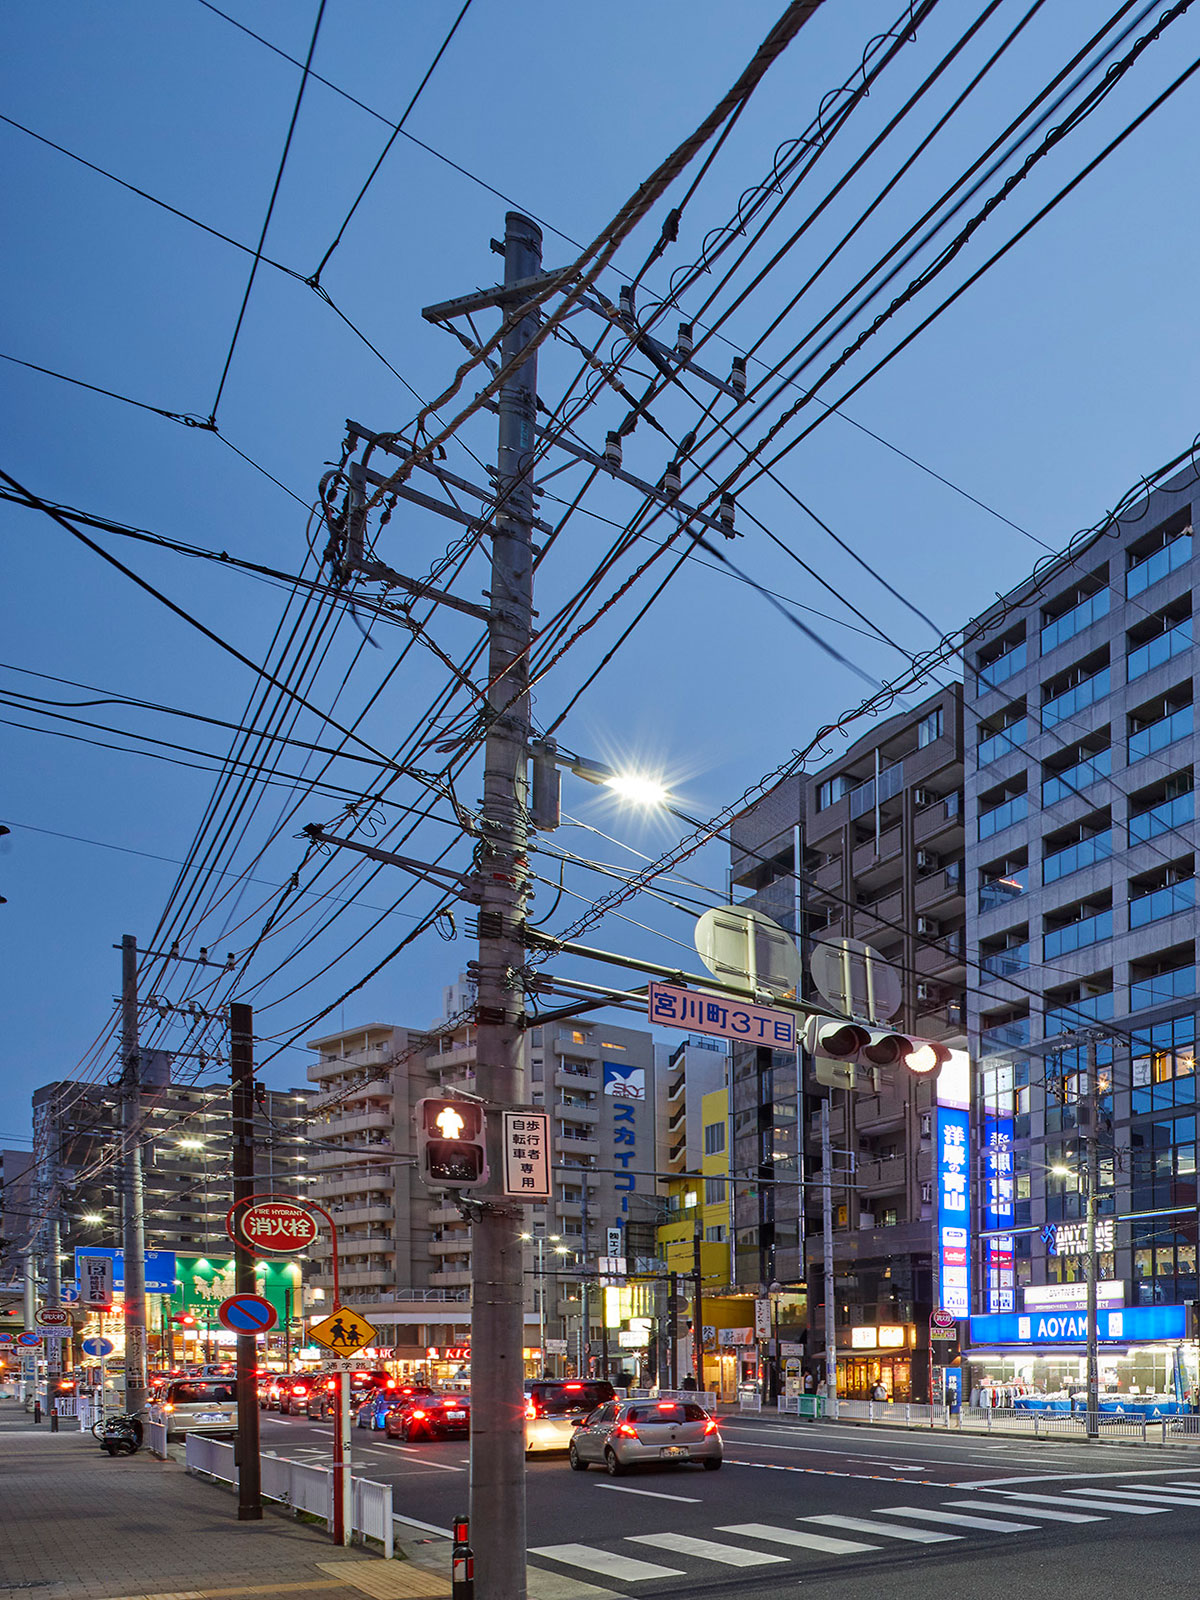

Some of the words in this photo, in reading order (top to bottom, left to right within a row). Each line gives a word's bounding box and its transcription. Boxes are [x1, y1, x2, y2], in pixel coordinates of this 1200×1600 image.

[653, 992, 792, 1043] 宮川町3丁目
[512, 1120, 526, 1159] 自転車
[526, 1120, 541, 1160] 歩行者
[520, 1163, 535, 1188] 専用
[942, 1124, 967, 1212] 洋服の青山
[271, 1209, 303, 1217] HYDRANT
[249, 1217, 311, 1238] 消火栓
[1055, 1220, 1114, 1243] ANYTME
[1056, 1236, 1114, 1256] FITNSS
[379, 1349, 393, 1358] KFC
